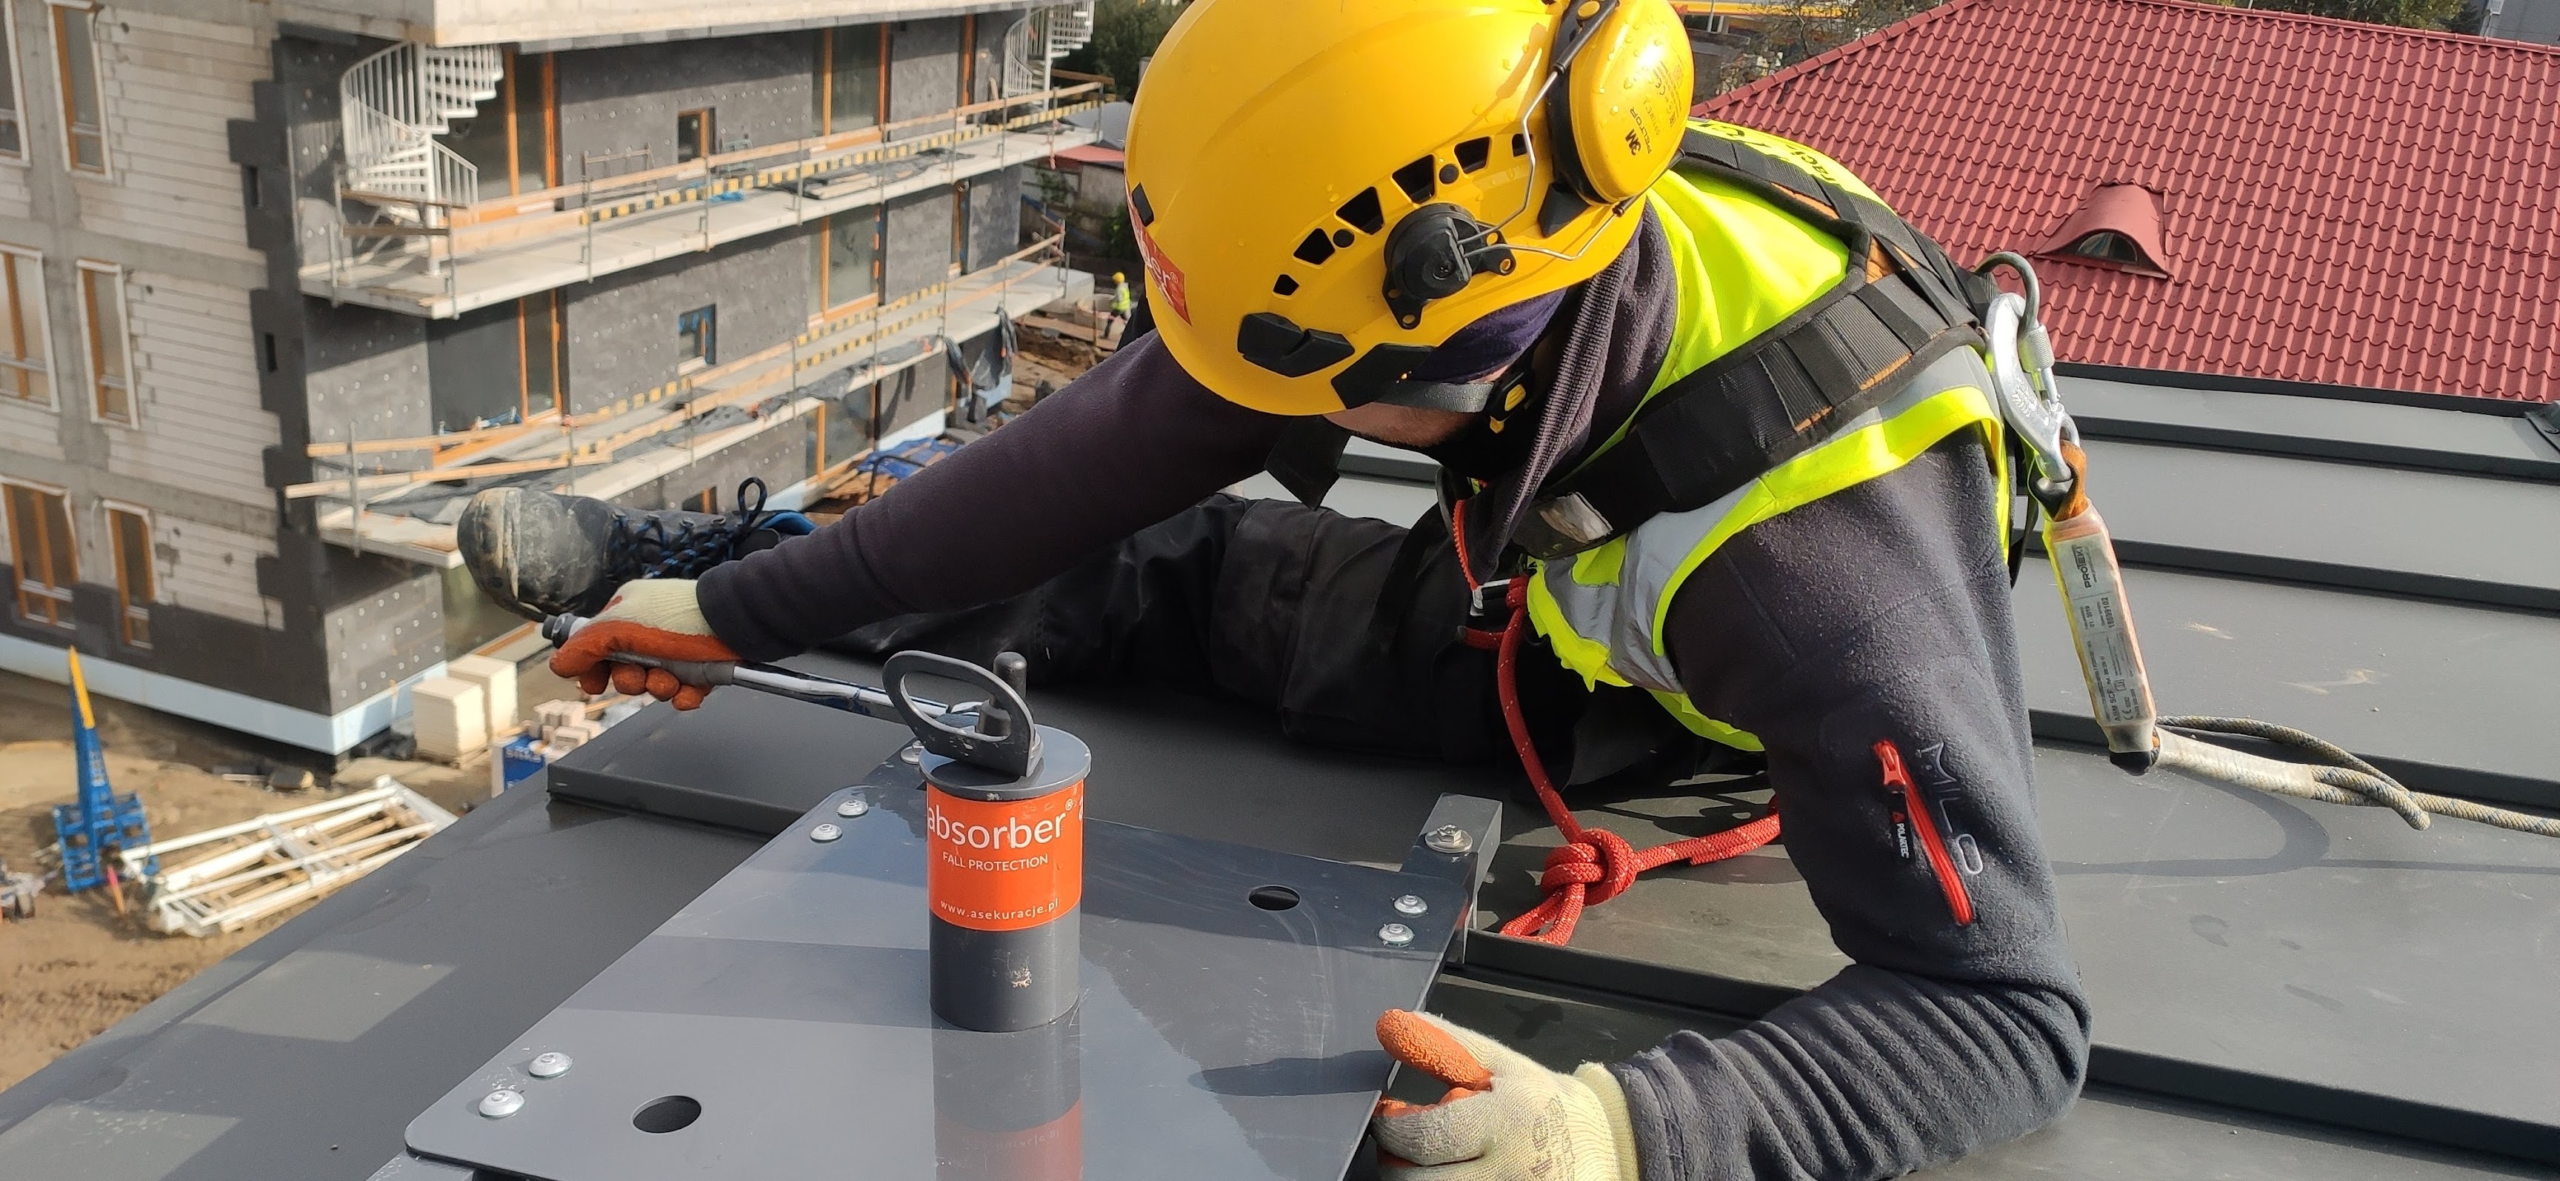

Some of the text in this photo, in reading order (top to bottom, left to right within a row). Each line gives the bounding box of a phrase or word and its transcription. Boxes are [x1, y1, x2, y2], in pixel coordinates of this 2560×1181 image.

[1625, 129, 1641, 156] 3M
[1629, 106, 1652, 154] PELTOR
[1896, 822, 1910, 859] POLARTEC
[942, 851, 1049, 872] FALL PROTECTION
[940, 898, 1059, 920] www.asekuracje.pl
